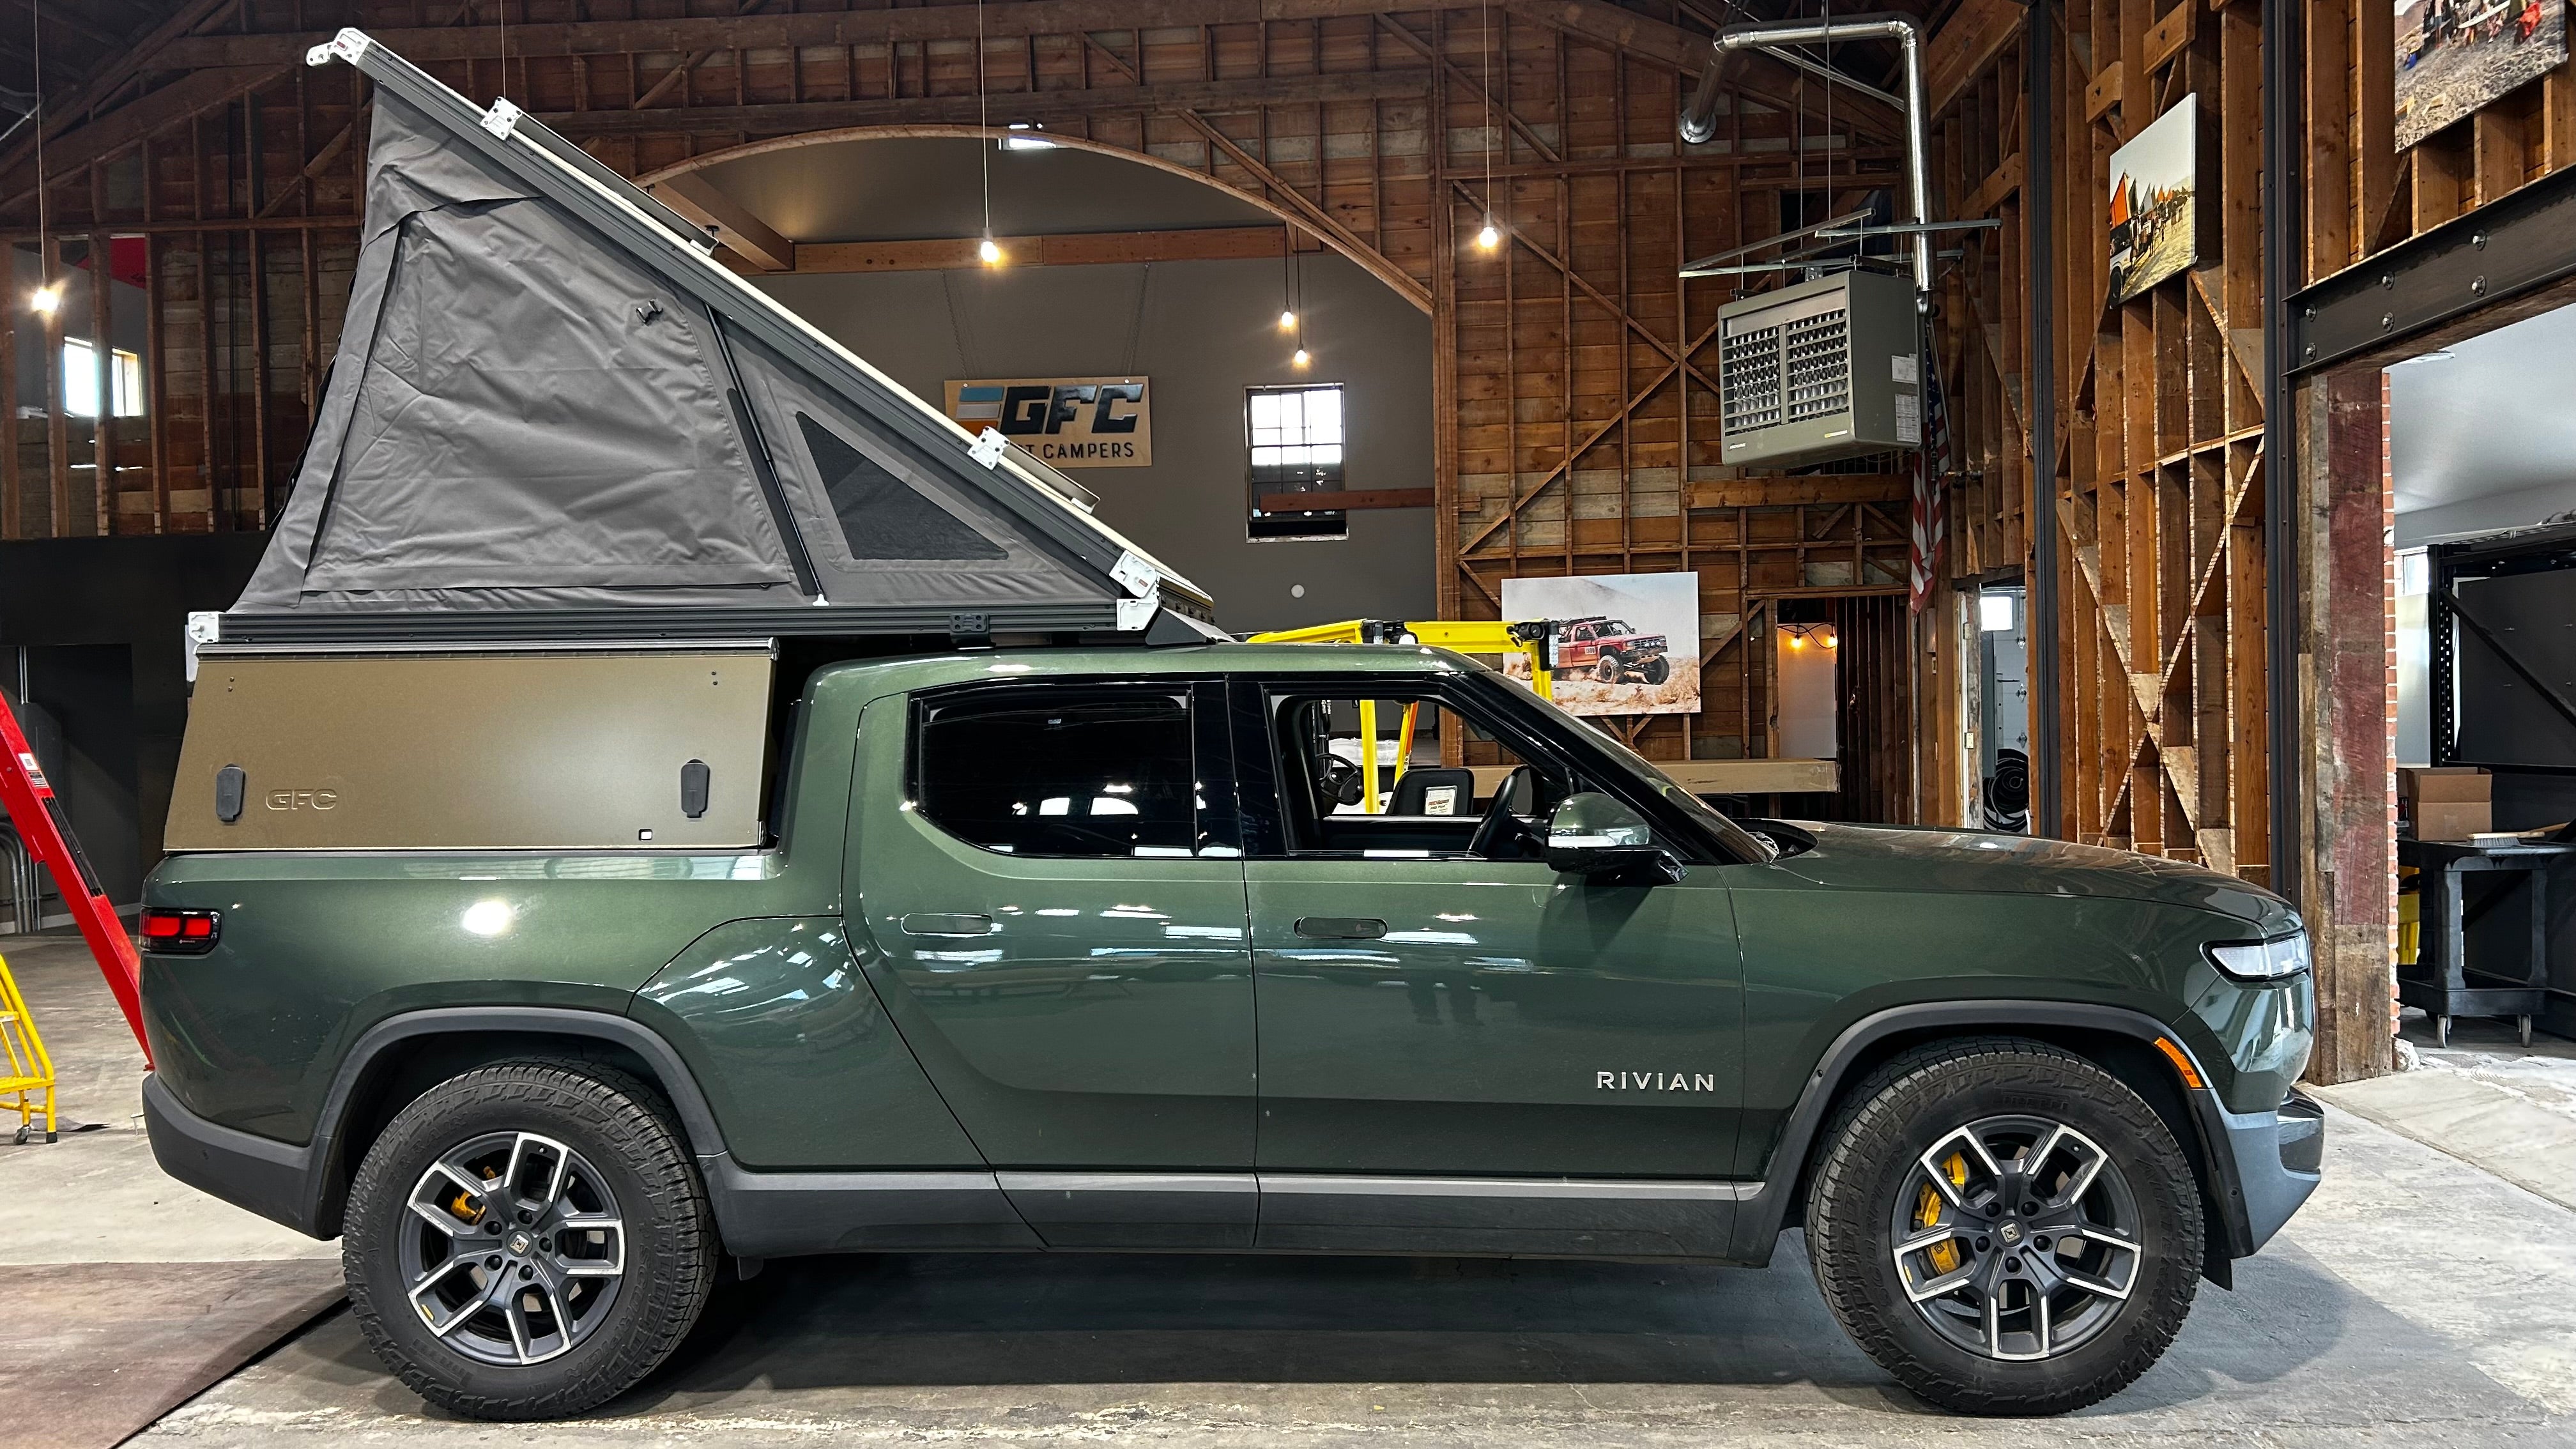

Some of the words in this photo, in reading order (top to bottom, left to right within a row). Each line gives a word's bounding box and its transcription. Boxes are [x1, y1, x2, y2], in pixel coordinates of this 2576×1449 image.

[999, 383, 1144, 435] GFC
[1042, 441, 1135, 459] CAMPERS
[265, 788, 337, 810] GFC
[1596, 1071, 1714, 1092] RIVIAN
[565, 1244, 648, 1383] SCORPION
